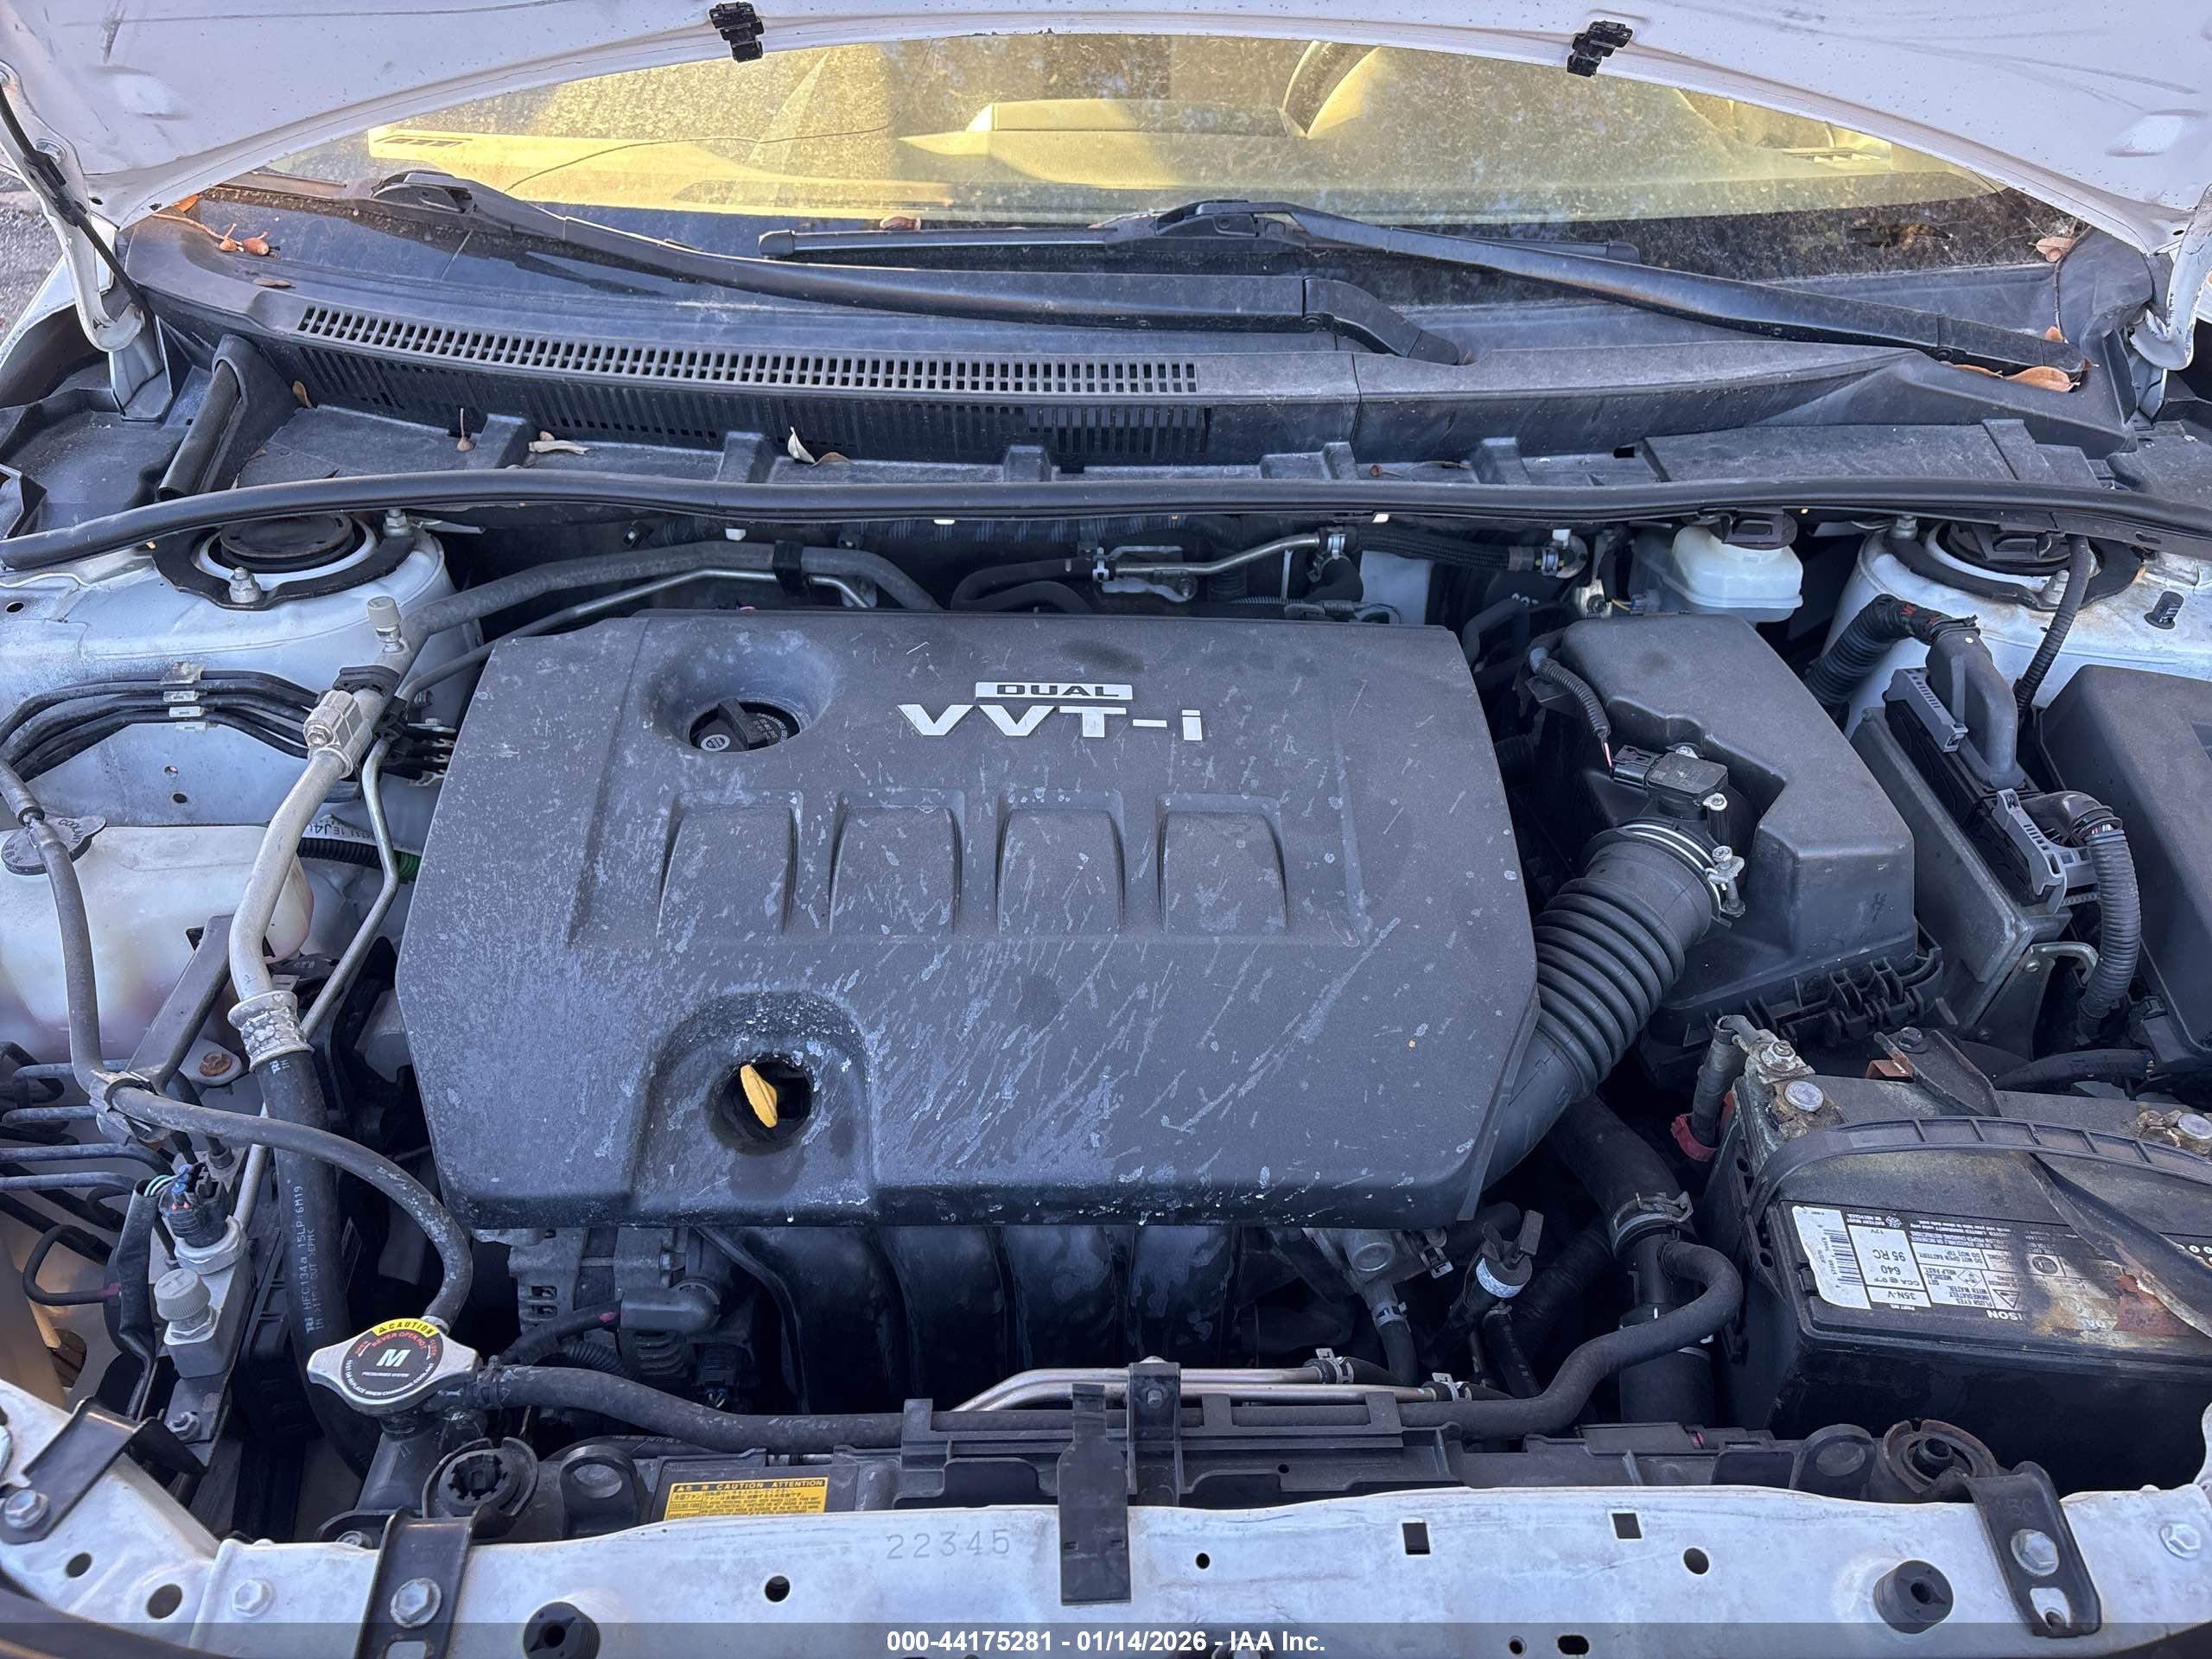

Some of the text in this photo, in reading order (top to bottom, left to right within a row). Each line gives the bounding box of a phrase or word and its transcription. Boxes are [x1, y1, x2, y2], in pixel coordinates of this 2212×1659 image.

[996, 684, 1119, 697] DUAL
[897, 703, 1203, 741] VVT-i
[1872, 1249, 1906, 1262] 95 RC
[1880, 1265, 1901, 1275] 640
[1887, 1290, 1916, 1300] 35N-V
[389, 1319, 435, 1334] CAUTION
[372, 1332, 397, 1348] NEVER
[398, 1332, 418, 1342] OPEN
[376, 1348, 411, 1367] M
[886, 1529, 1010, 1560] 22345
